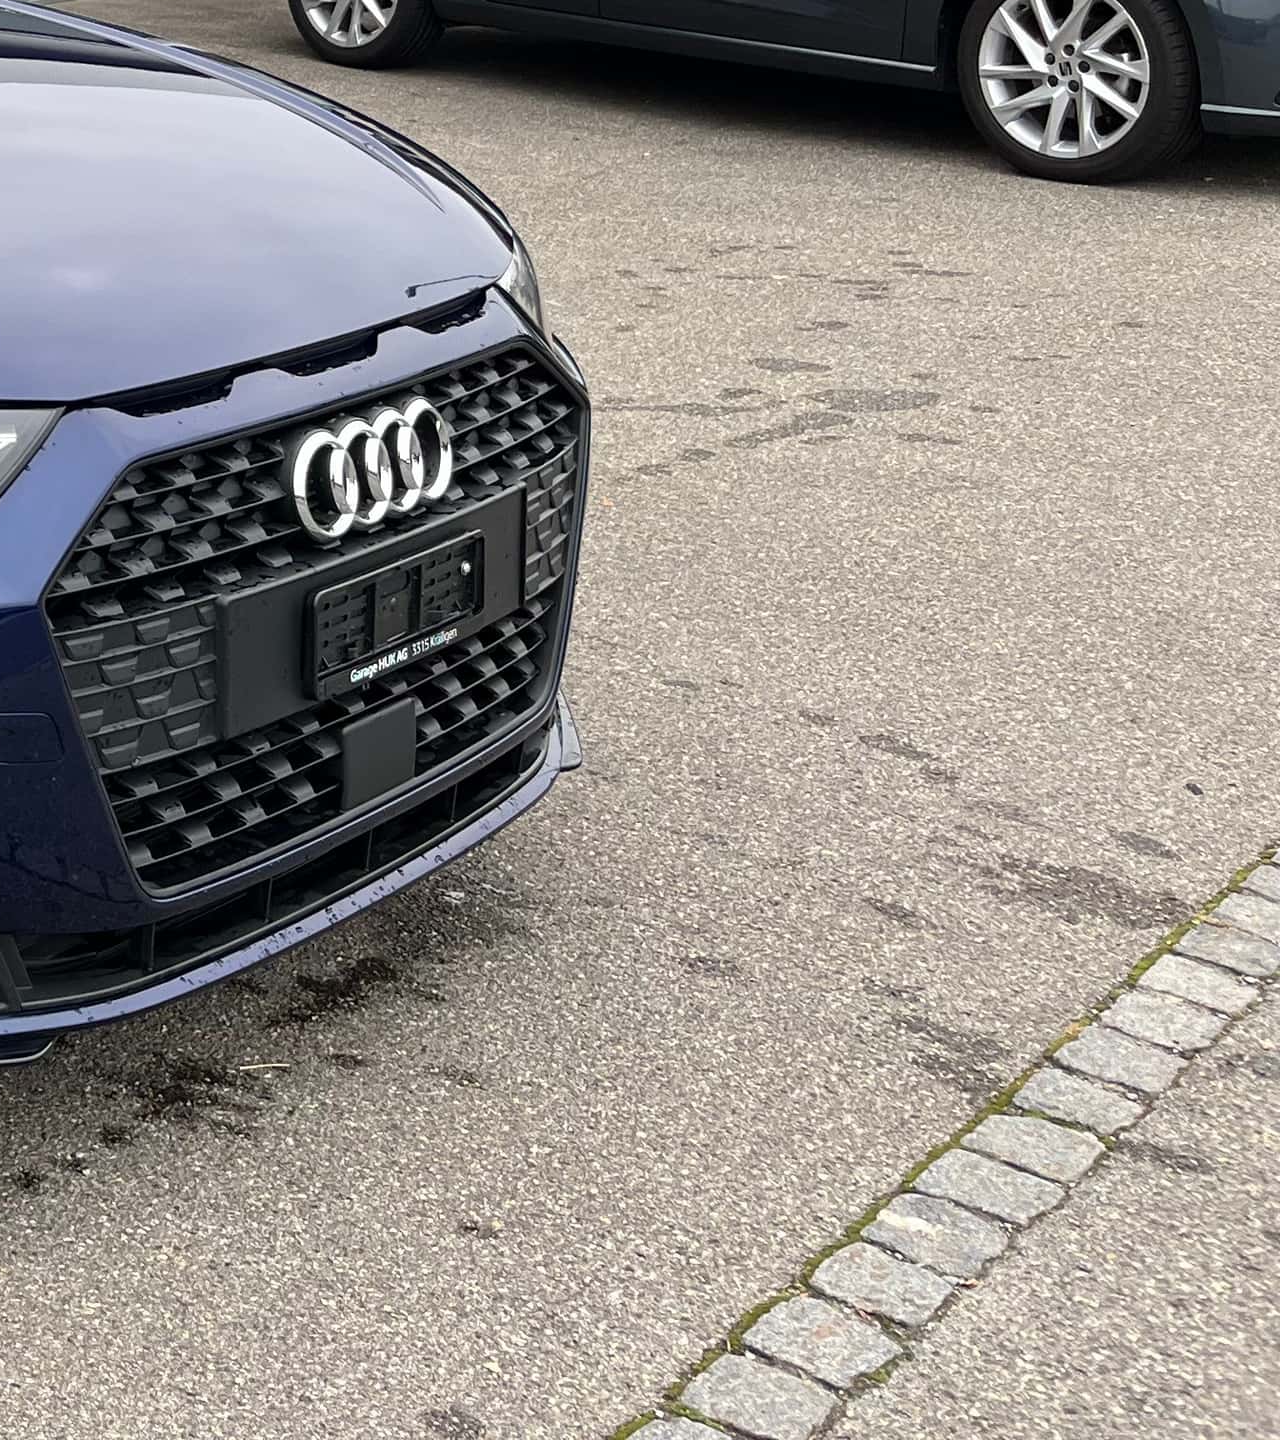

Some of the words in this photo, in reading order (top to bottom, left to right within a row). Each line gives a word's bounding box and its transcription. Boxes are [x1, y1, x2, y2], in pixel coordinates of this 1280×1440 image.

[350, 662, 379, 683] Garage
[378, 652, 397, 671] HUK
[397, 647, 409, 663] AG
[411, 637, 430, 657] 3315
